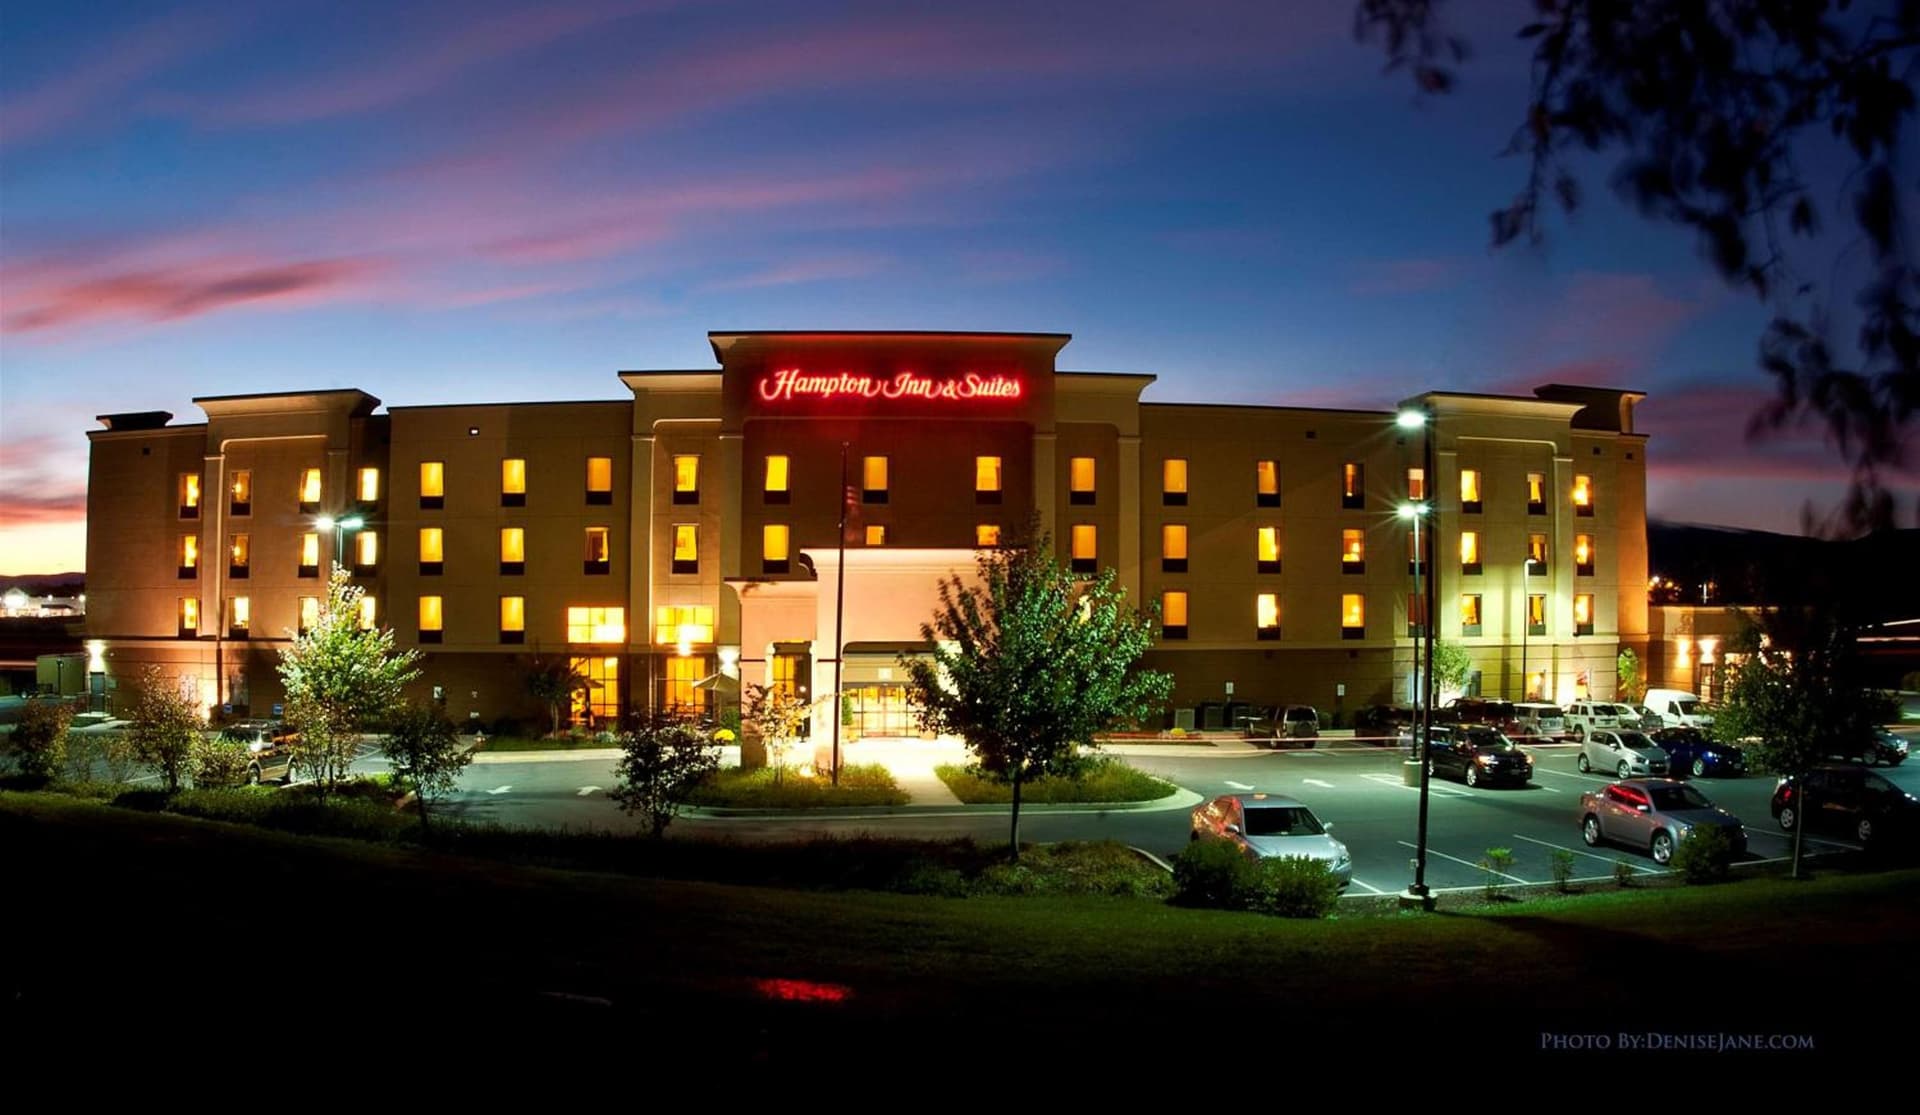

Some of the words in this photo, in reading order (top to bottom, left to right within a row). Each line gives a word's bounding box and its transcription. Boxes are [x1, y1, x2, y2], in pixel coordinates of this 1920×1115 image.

[759, 368, 882, 400] Hampton
[882, 372, 942, 399] Inn
[942, 379, 958, 399] &
[956, 373, 1021, 398] Suites
